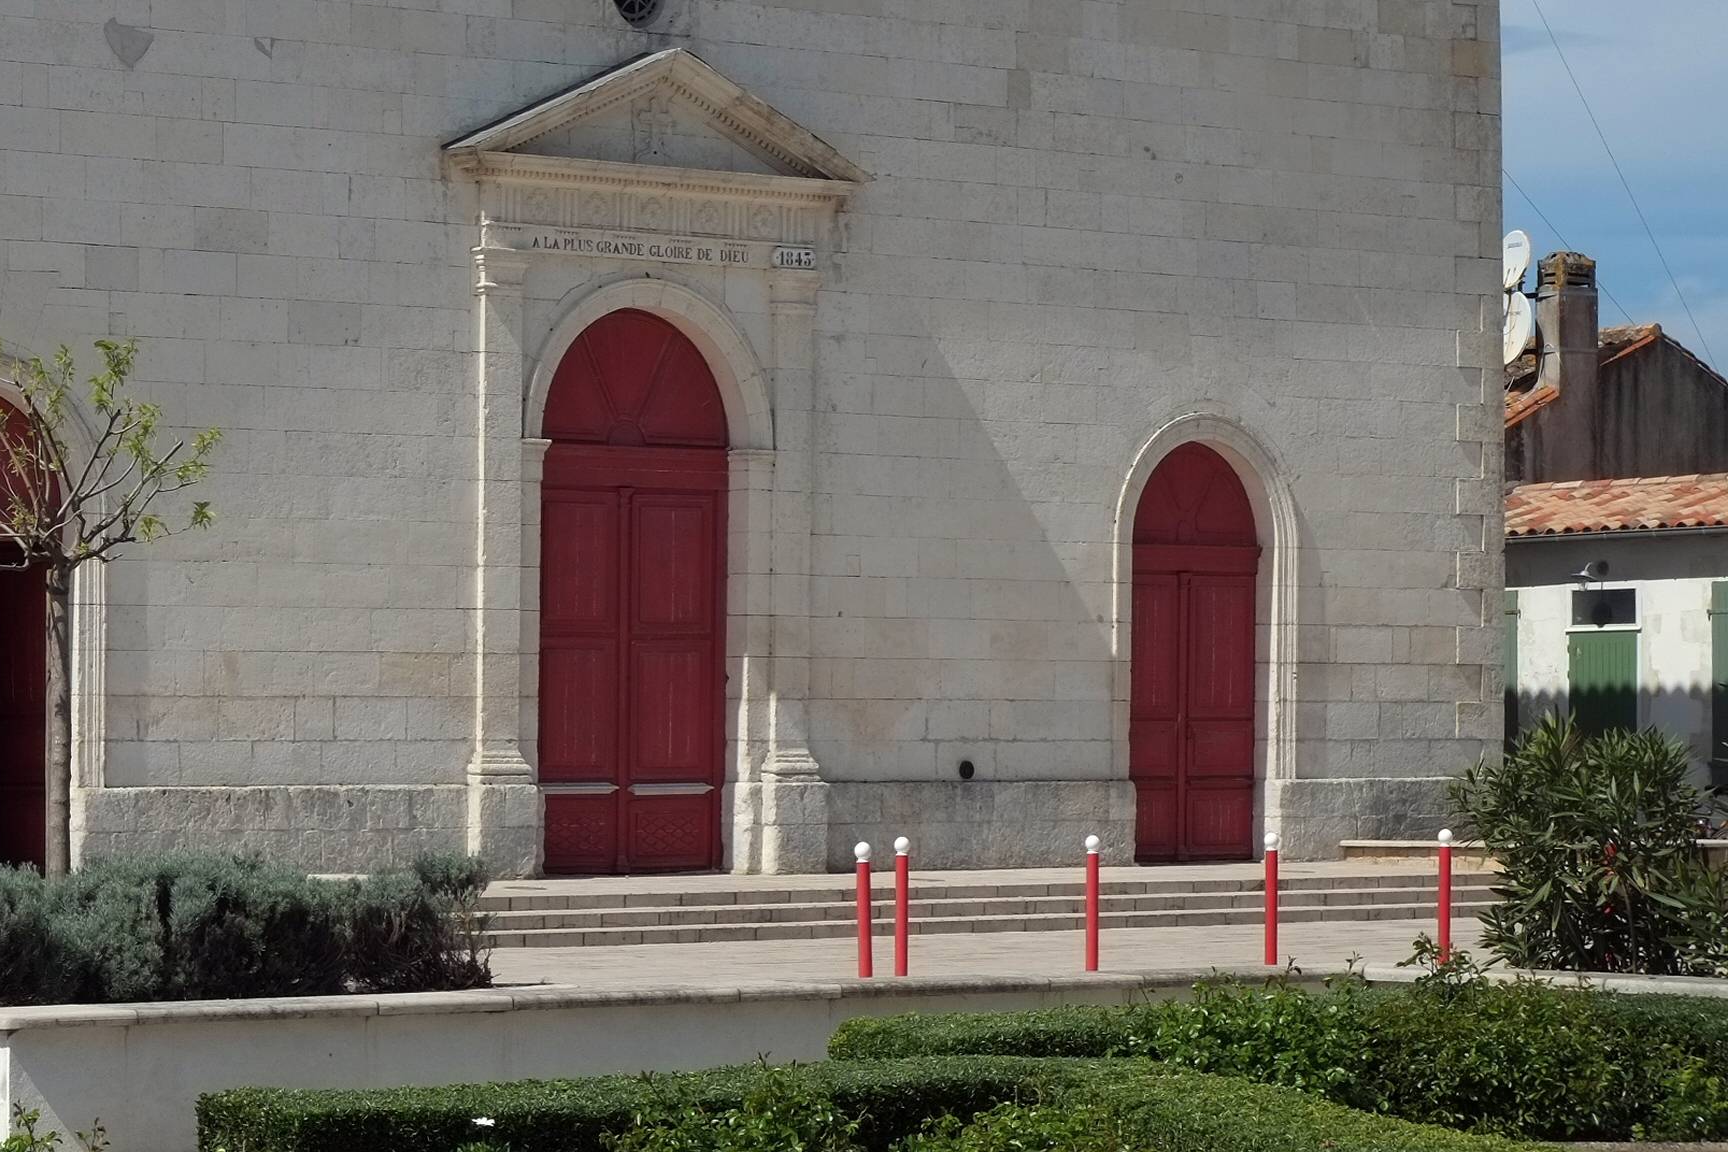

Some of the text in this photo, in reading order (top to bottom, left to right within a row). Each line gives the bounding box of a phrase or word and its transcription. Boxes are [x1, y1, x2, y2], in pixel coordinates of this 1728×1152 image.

[532, 236, 750, 264] A LA PLUS GRANDE GLOIRE DE DIEU
